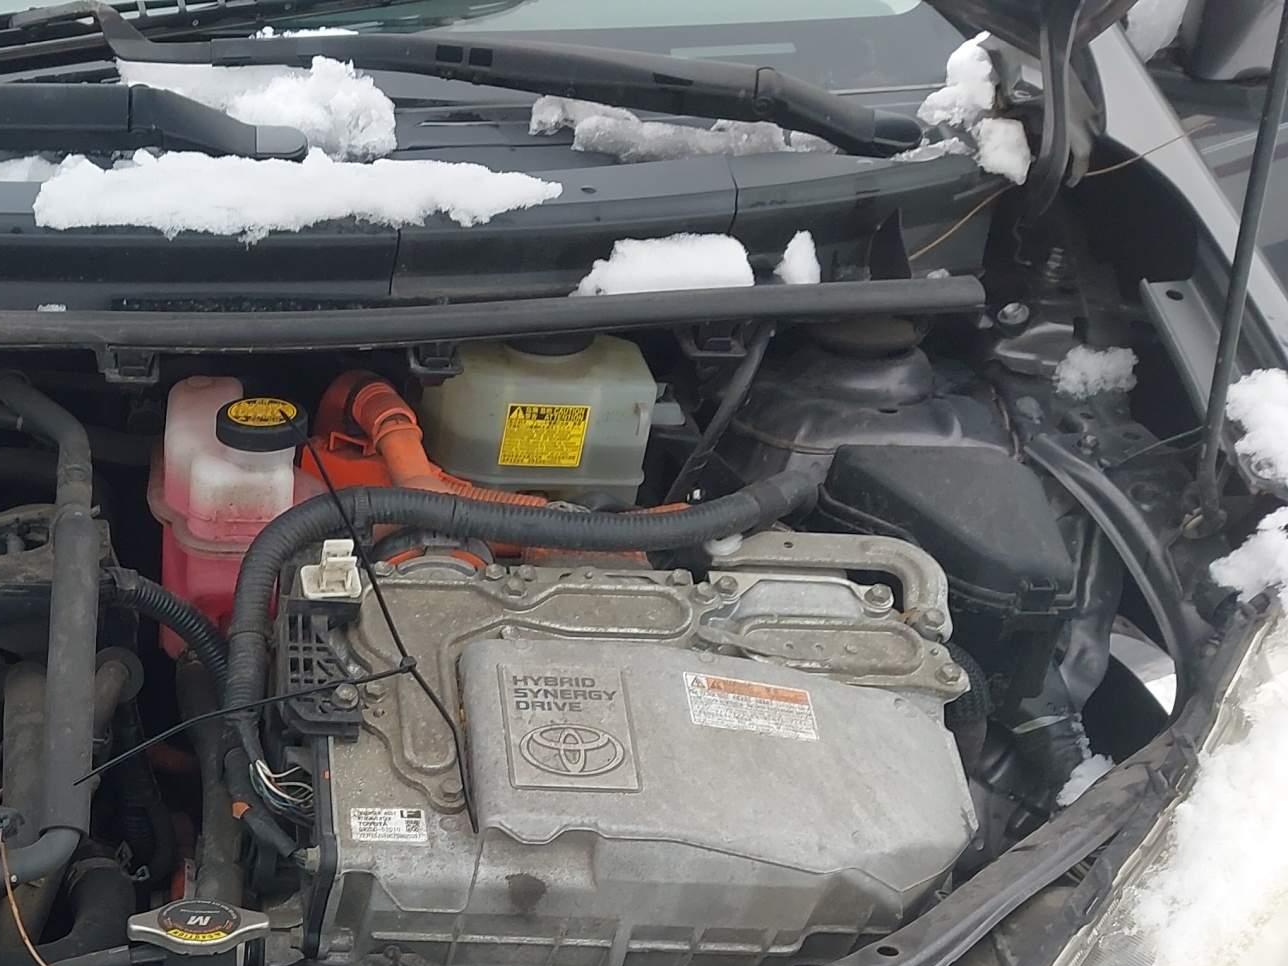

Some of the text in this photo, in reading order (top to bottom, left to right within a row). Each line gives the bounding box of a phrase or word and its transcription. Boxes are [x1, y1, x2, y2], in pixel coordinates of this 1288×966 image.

[512, 675, 596, 688] HYBRID
[513, 688, 617, 701] SYNERGY
[516, 701, 583, 712] DRIVE
